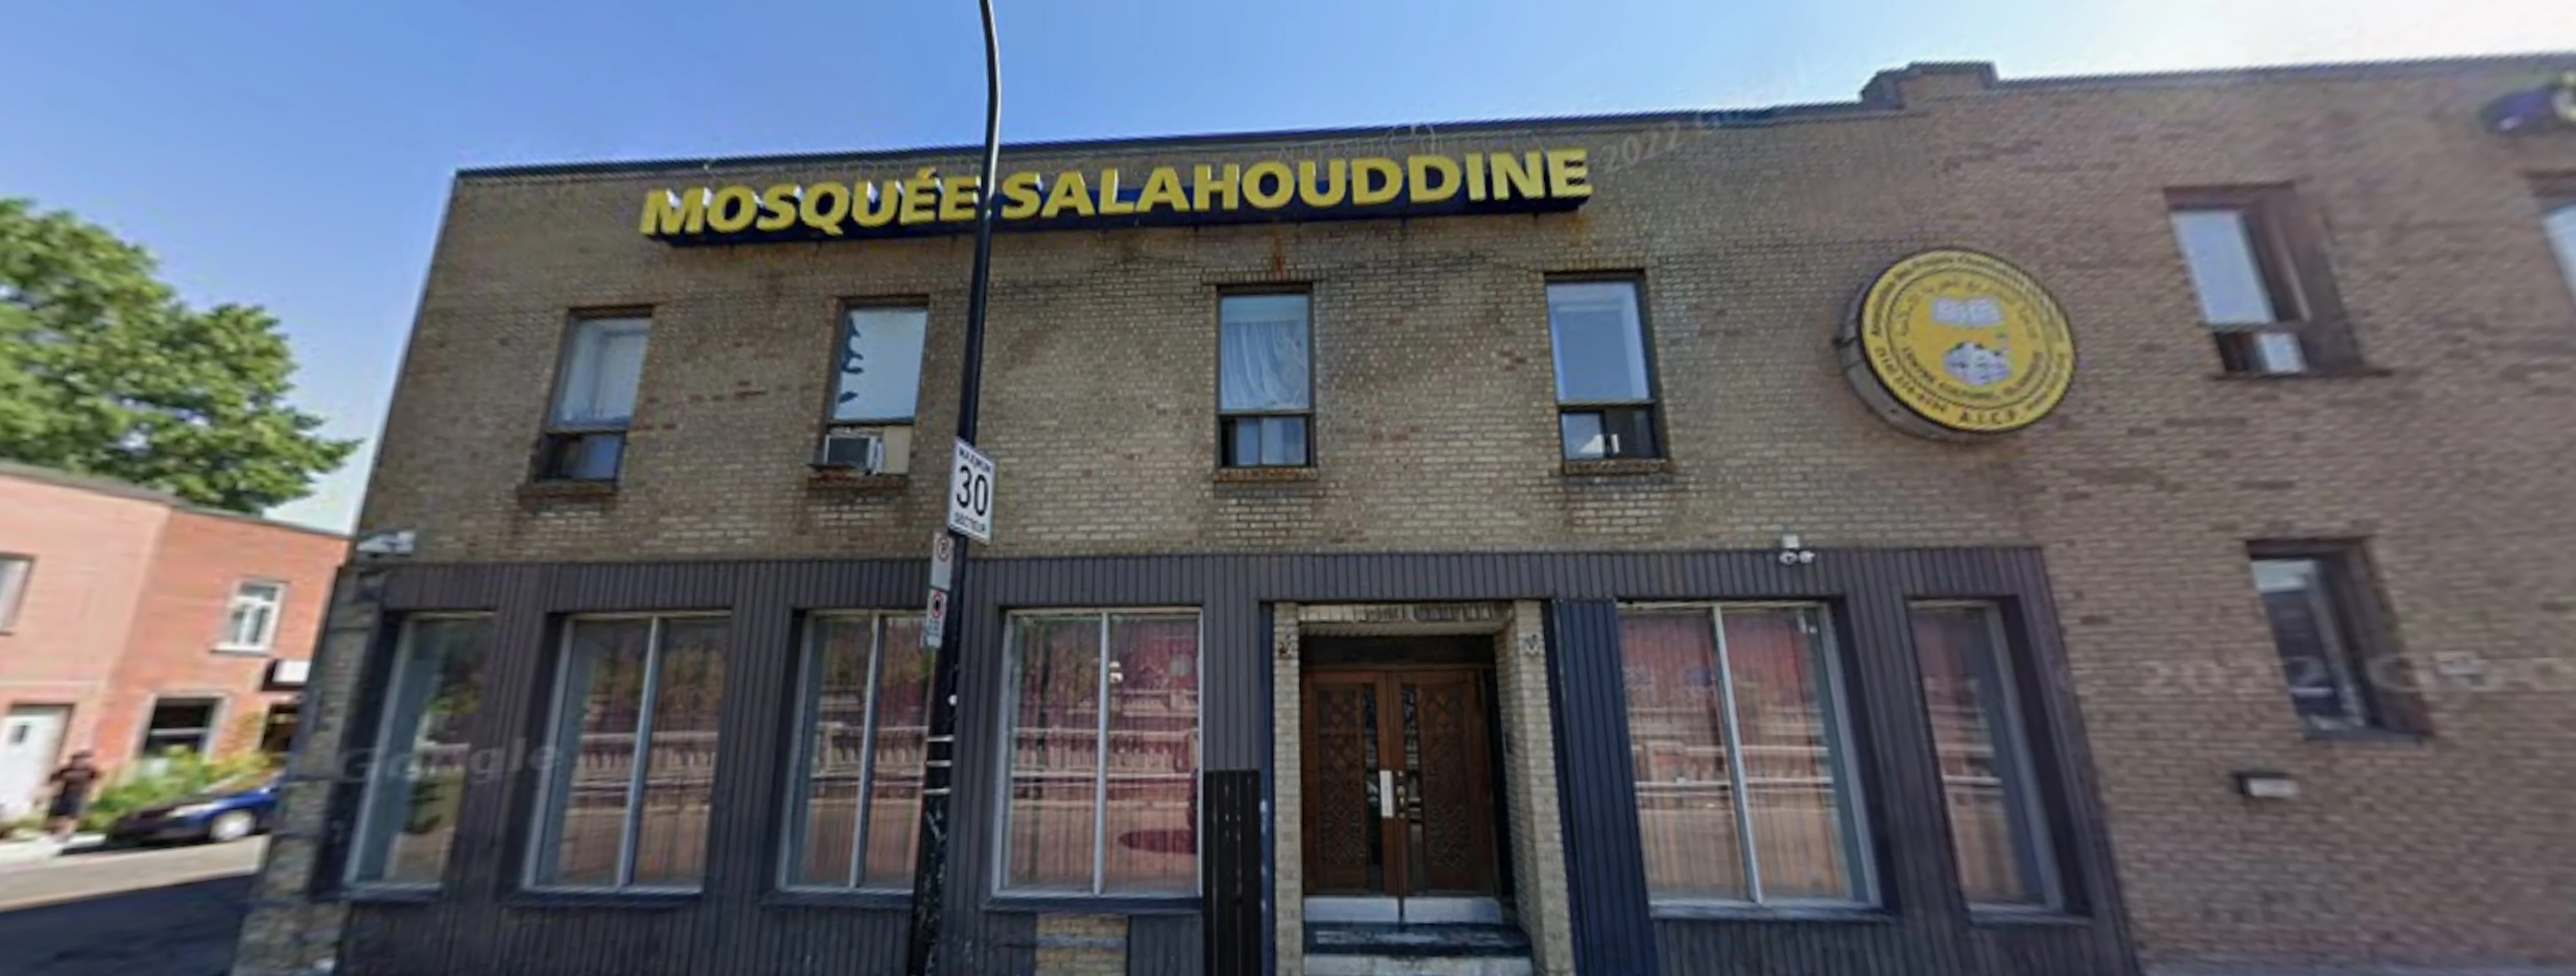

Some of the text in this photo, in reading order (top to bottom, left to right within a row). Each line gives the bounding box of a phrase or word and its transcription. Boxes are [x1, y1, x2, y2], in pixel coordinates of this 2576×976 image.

[640, 148, 1593, 236] MOSQUÉE SALAHOUDDINE
[956, 464, 989, 517] 30
